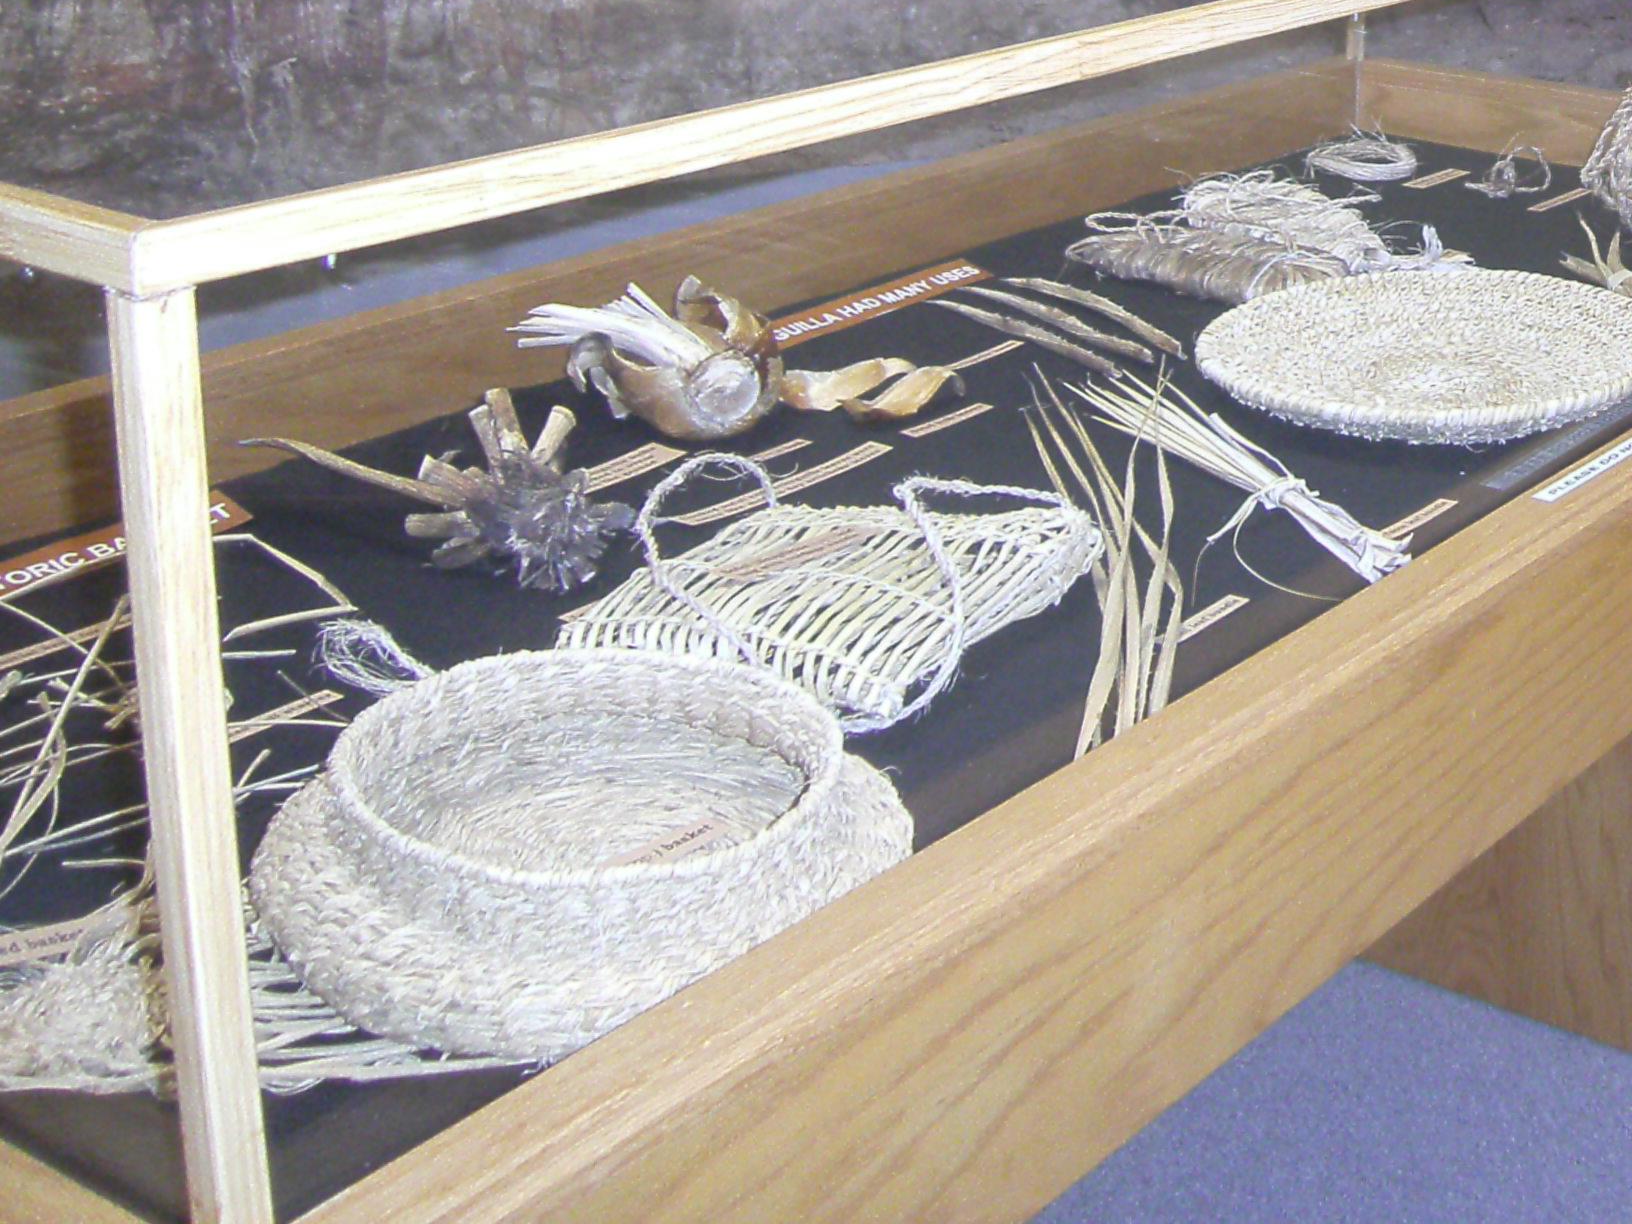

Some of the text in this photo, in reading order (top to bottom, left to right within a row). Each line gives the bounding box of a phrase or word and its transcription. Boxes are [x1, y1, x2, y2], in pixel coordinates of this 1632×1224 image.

[774, 264, 981, 343] GUILLA HAD MANY USES
[1546, 464, 1599, 497] PLEASE
[1599, 448, 1621, 467] DO
[0, 552, 85, 590] ORIC
